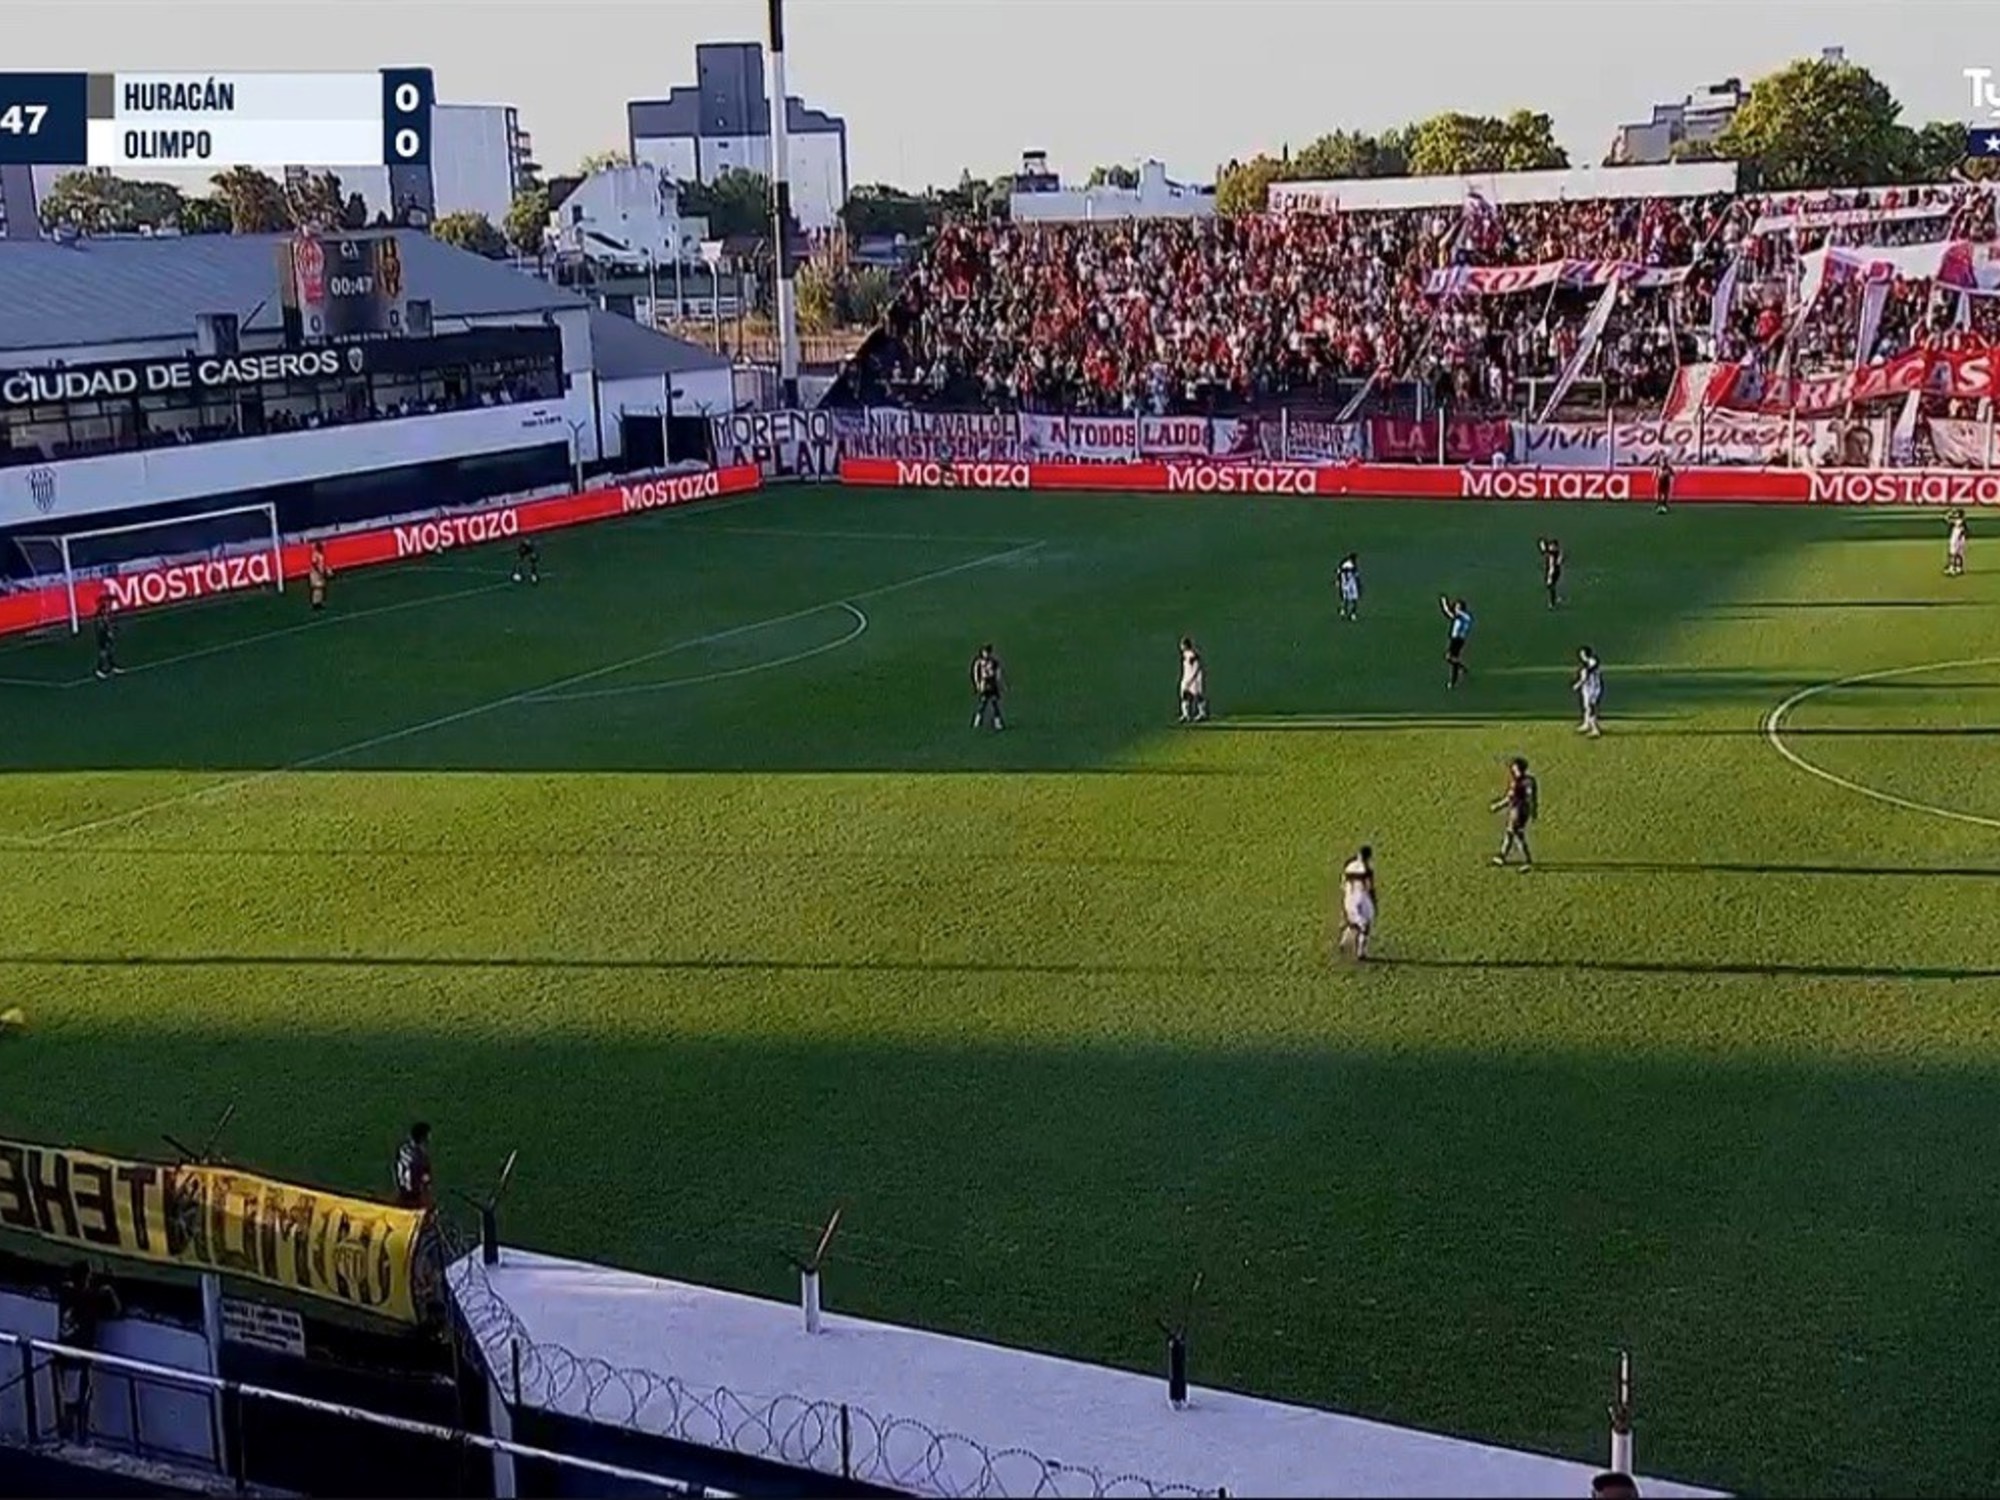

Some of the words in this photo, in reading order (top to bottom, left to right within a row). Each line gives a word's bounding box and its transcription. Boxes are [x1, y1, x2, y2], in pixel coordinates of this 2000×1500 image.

[4, 369, 137, 403] CIUDAD
[147, 363, 191, 389] DE
[199, 350, 340, 385] CASEROS
[714, 411, 829, 447] MORENO
